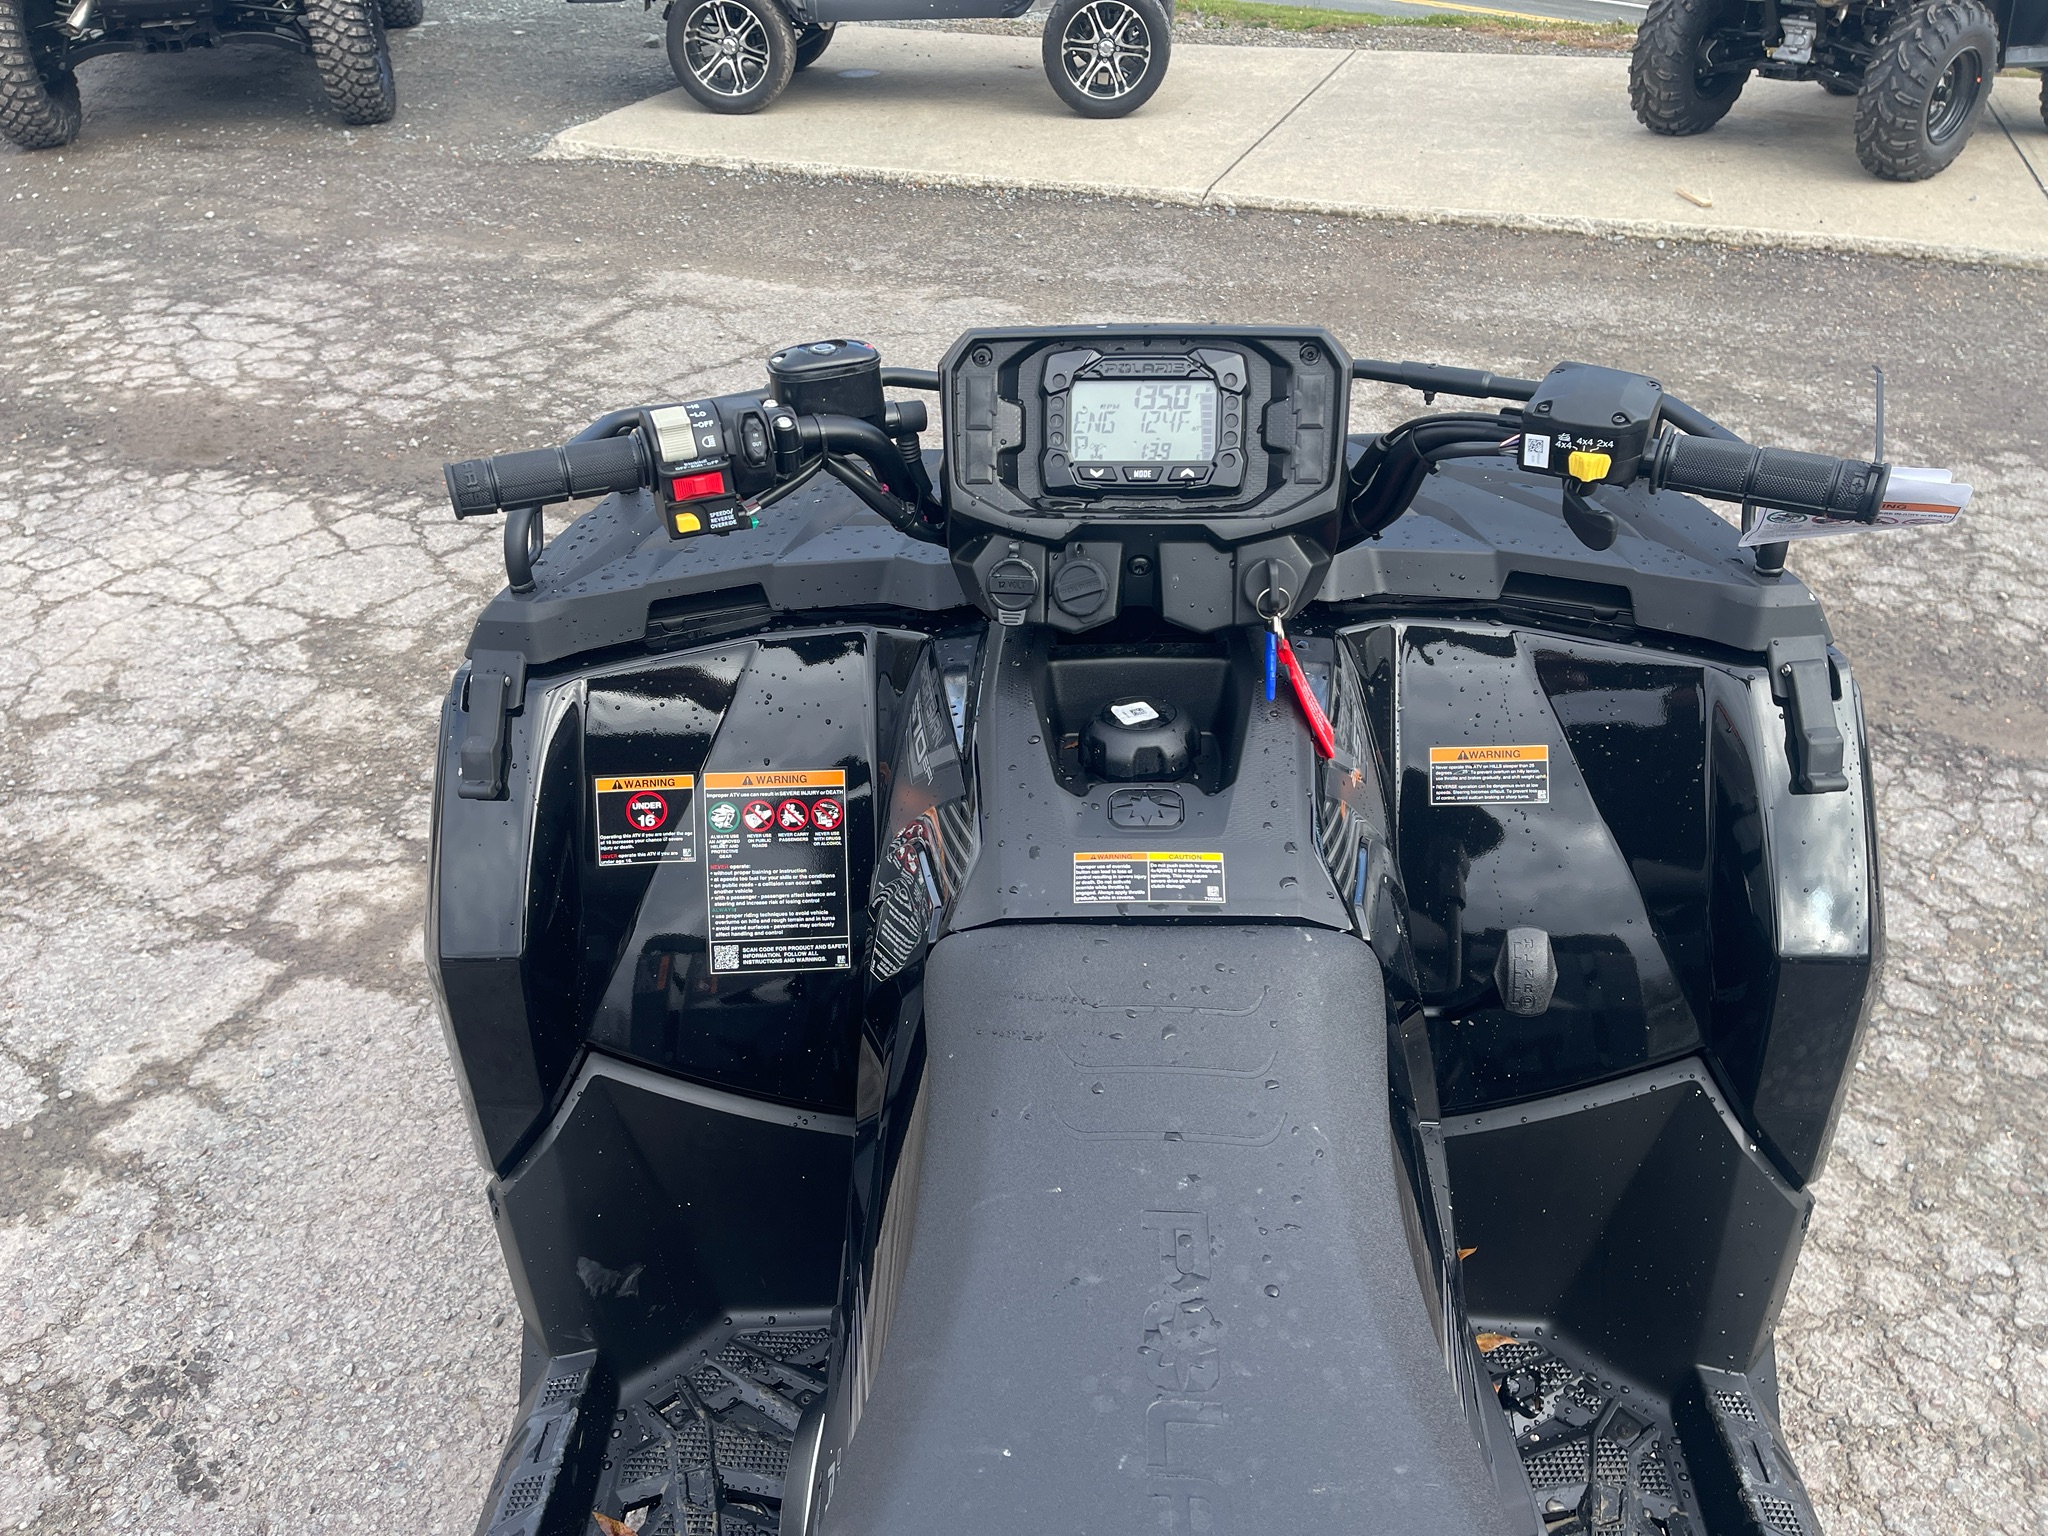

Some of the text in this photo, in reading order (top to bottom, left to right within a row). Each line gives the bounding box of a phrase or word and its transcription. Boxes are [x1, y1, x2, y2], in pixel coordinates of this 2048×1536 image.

[1104, 362, 1186, 373] POLARIS
[1134, 385, 1191, 410] 1350
[698, 419, 714, 428] OFF
[1073, 410, 1116, 434] ENG
[1555, 440, 1572, 449] 4x4
[1576, 437, 1594, 446] 4x4
[1596, 439, 1614, 449] 2x4
[1133, 469, 1152, 478] MODE
[710, 508, 734, 518] SPEEDO/
[710, 514, 734, 524] REVERSE
[710, 520, 738, 529] OVERRIDE
[1008, 581, 1026, 590] VOLT
[1468, 750, 1521, 759] WARNING
[624, 778, 675, 789] WARNING
[756, 775, 807, 784] WARNING
[632, 801, 662, 810] UNDER
[638, 814, 656, 827] 16
[1524, 969, 1534, 978] N
[1524, 984, 1532, 993] R
